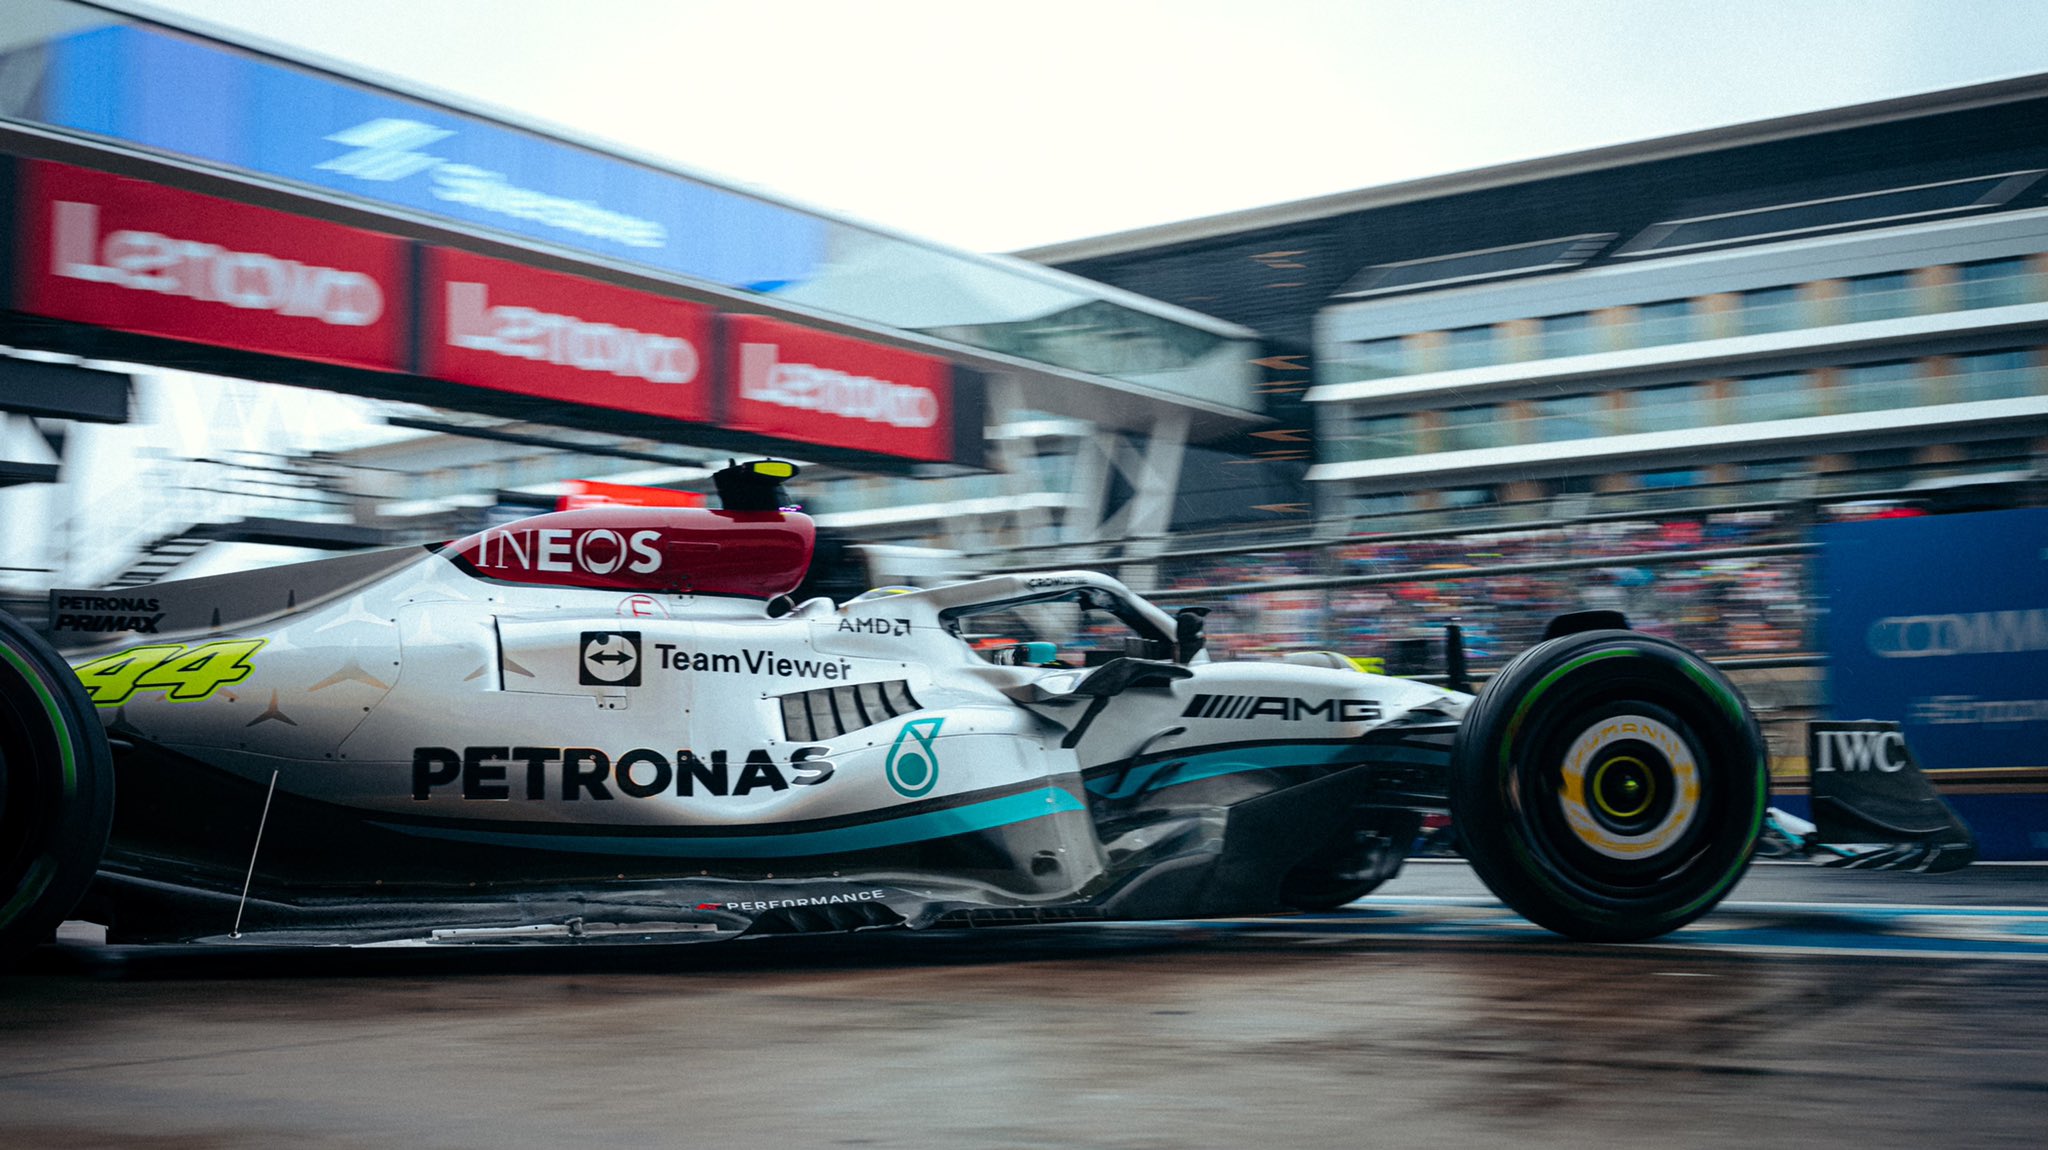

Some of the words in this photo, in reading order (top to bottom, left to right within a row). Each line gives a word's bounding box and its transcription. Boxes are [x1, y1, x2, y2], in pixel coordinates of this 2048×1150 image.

[475, 528, 662, 574] INEOS
[58, 596, 160, 612] PETRONAS
[54, 613, 166, 634] PRIMAX
[838, 618, 890, 635] AMD
[73, 638, 269, 708] 44
[655, 643, 852, 680] TeamViewer
[1246, 695, 1383, 722] AMG
[1815, 731, 1906, 772] IWC
[412, 746, 837, 801] PETRONAS
[727, 889, 886, 910] PERFORMANCE
